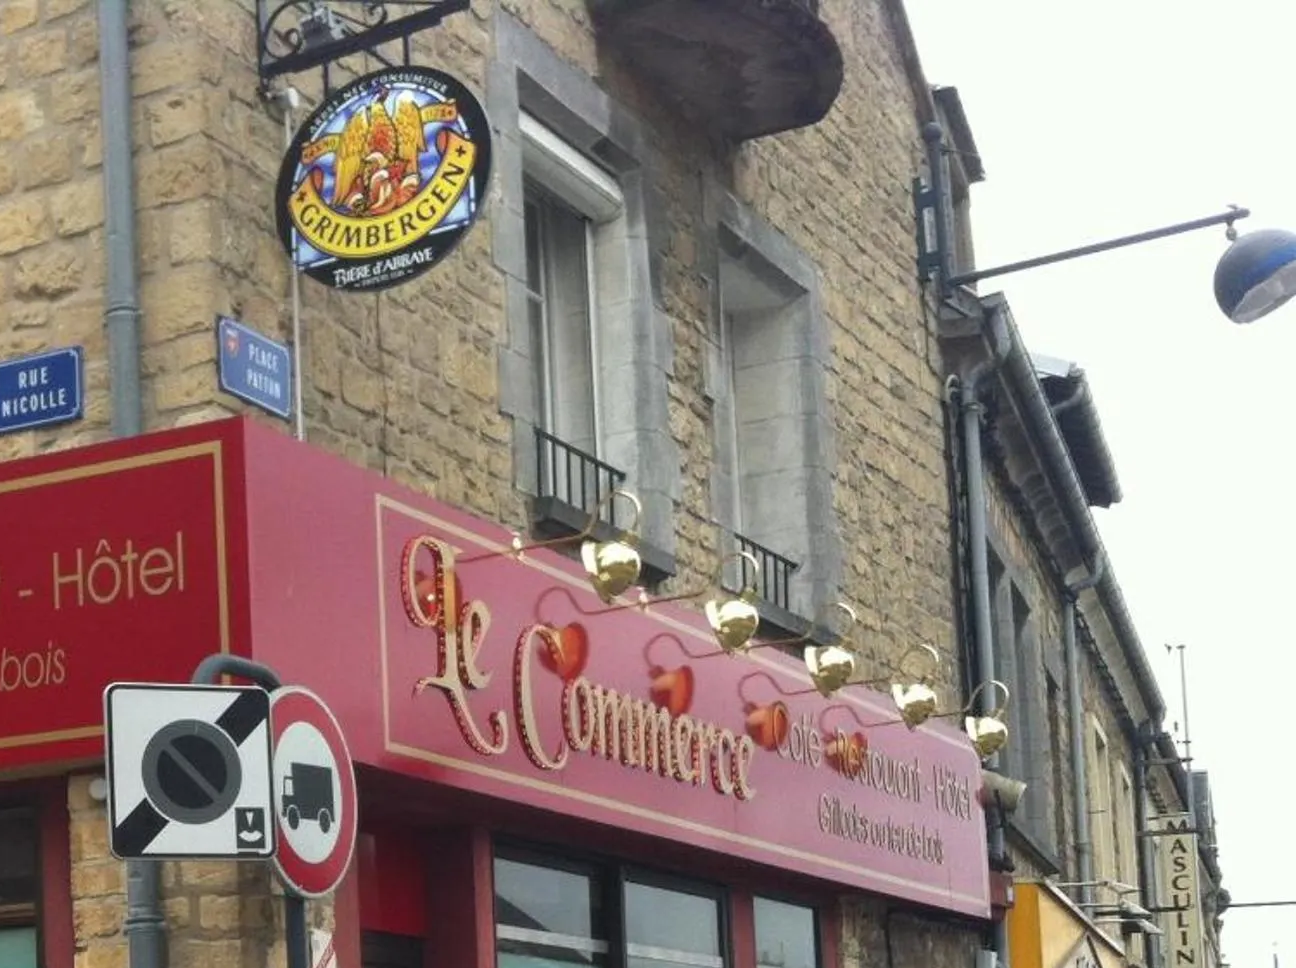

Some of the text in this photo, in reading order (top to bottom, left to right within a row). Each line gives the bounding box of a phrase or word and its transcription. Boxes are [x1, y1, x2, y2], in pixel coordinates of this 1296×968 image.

[300, 162, 465, 248] GRIMBERGEN
[18, 366, 49, 389] RUE
[248, 342, 279, 374] PLACE
[1, 388, 67, 418] NICOLLE
[53, 531, 186, 610] Hôtel
[0, 641, 66, 692] bois
[401, 535, 757, 802] Le Commerce
[1166, 819, 1196, 966] MASCULIN
